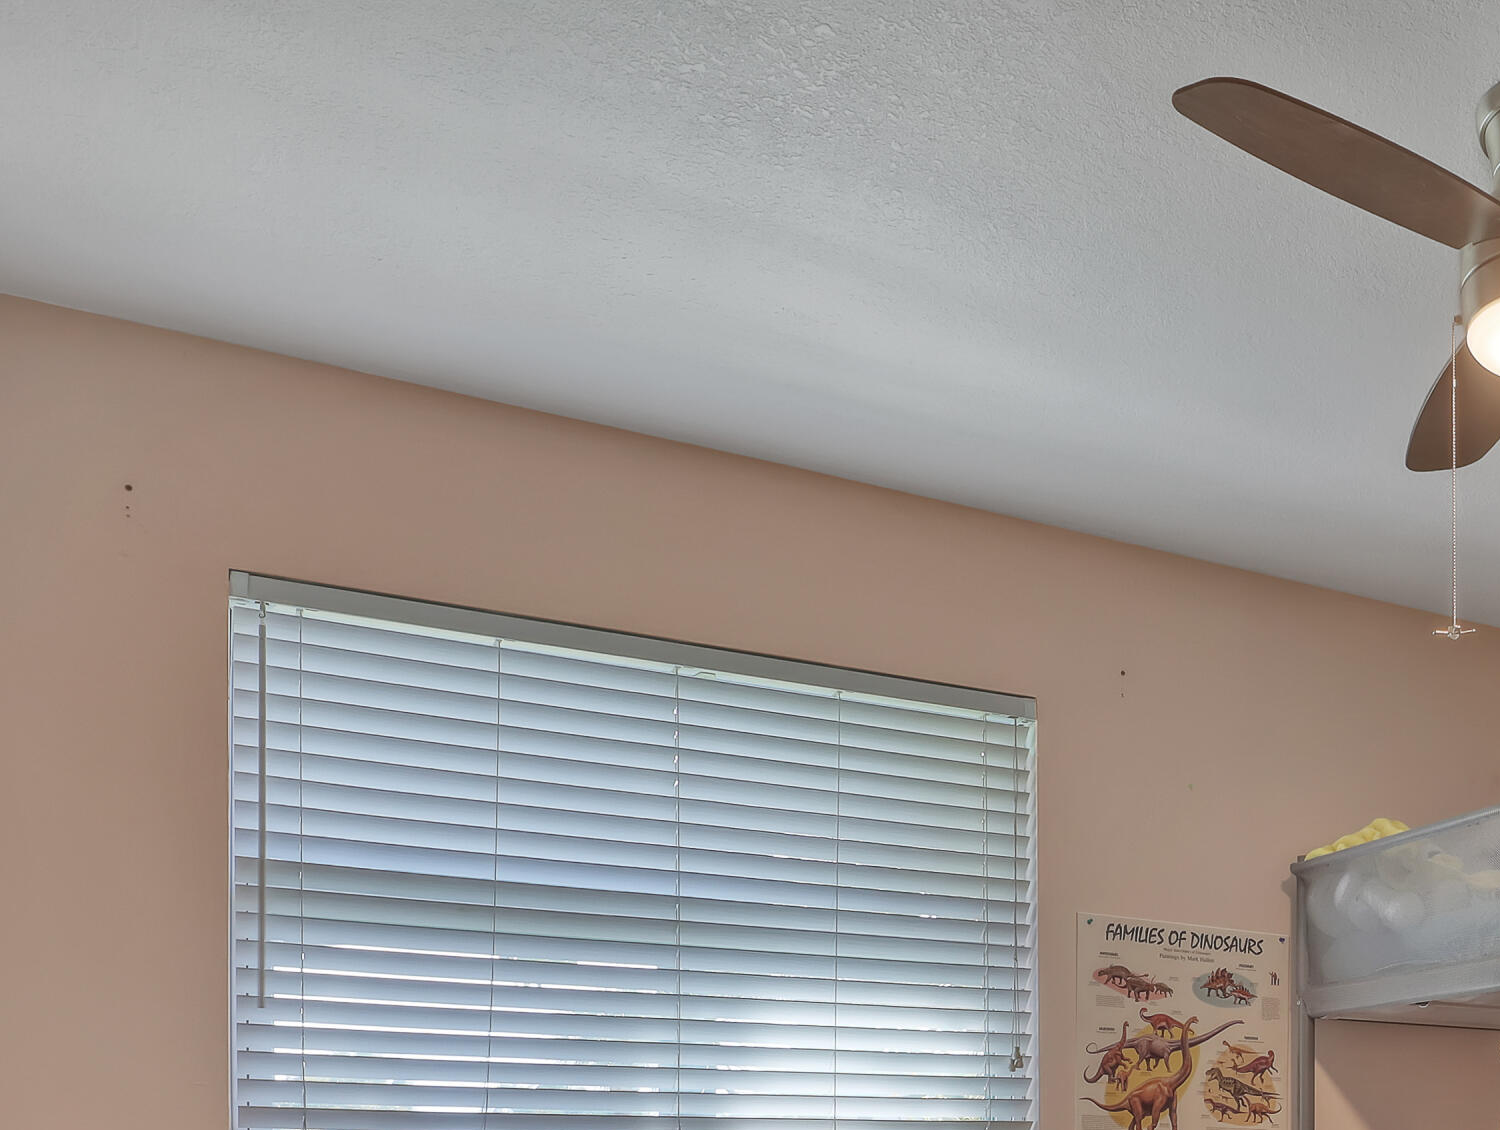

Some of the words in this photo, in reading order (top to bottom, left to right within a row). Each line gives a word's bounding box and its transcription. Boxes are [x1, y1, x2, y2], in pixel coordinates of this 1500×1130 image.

[1105, 923, 1165, 945] FAMILIES
[1168, 930, 1187, 948] OF
[1190, 931, 1264, 956] DINOSAURS
